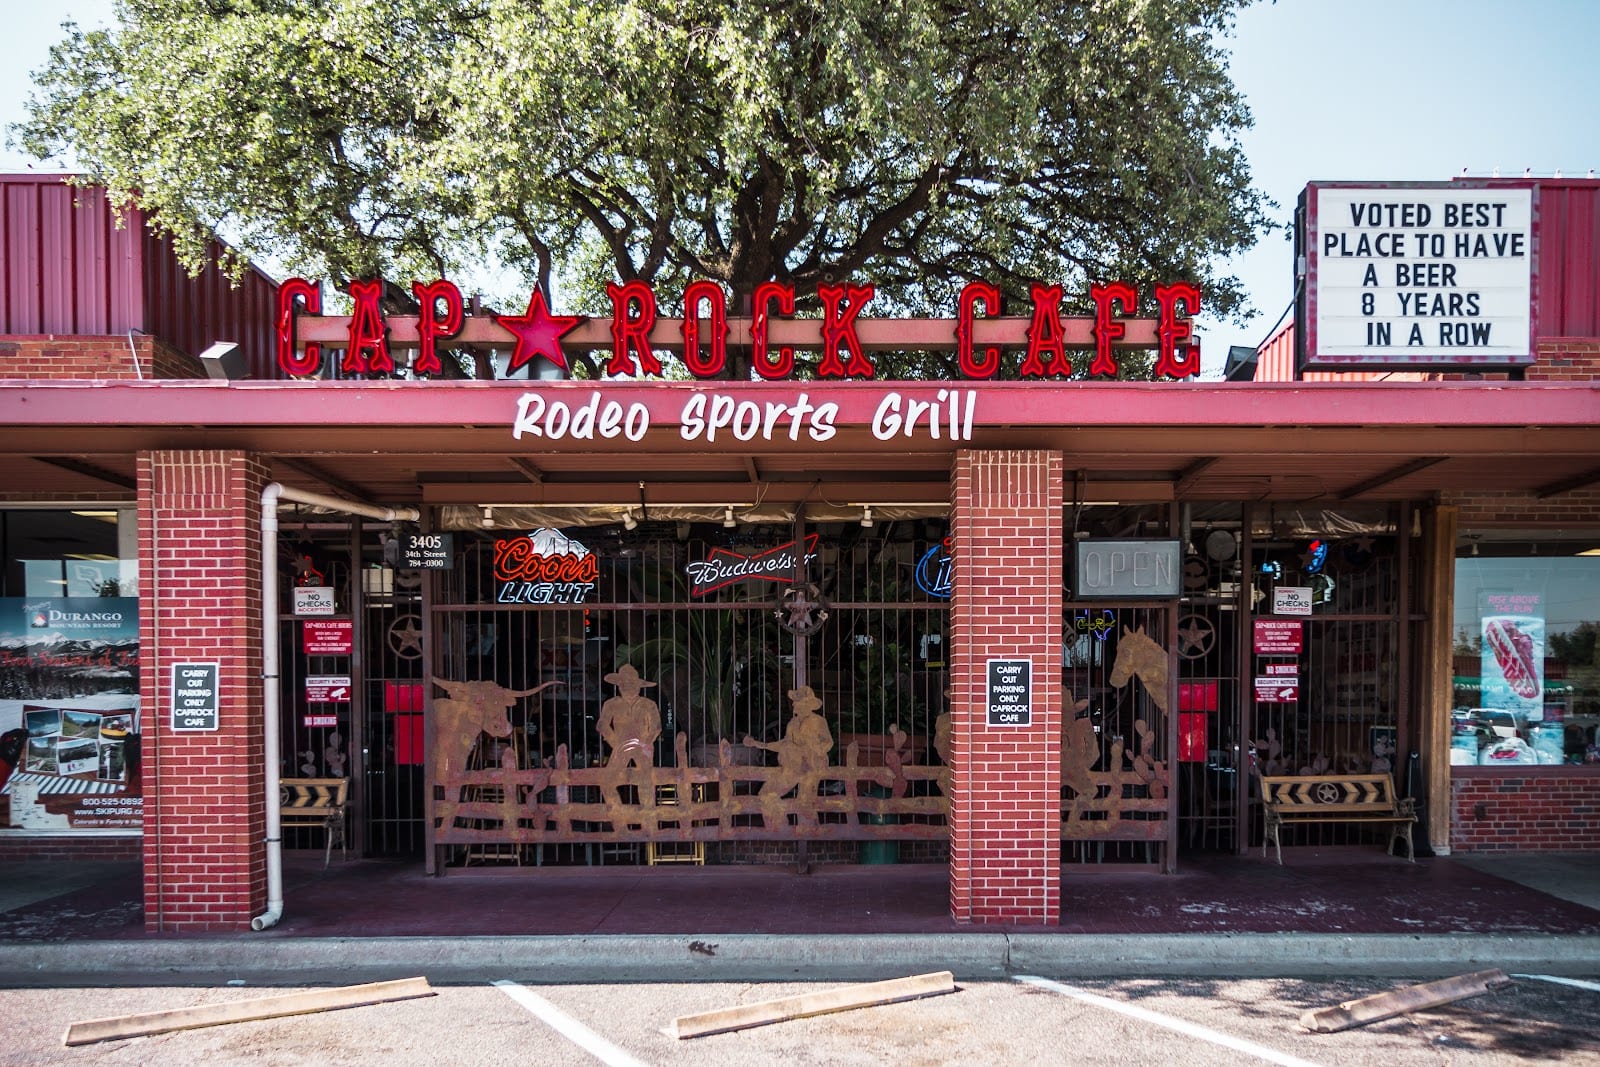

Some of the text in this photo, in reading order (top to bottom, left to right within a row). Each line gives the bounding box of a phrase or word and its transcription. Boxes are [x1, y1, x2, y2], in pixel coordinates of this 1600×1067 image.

[1350, 202, 1508, 228] VOTED BEST
[1323, 232, 1525, 258] PLACE TO HAVE
[1362, 263, 1458, 287] A BEER
[1361, 292, 1481, 317] 8 YEARS
[275, 277, 1202, 379] CAP ROCK CAFE
[1367, 322, 1492, 347] IN A ROW
[511, 391, 650, 442] Rodeo
[871, 390, 977, 442] Grill
[409, 535, 442, 549] 3405
[494, 536, 600, 583] Coors
[1086, 551, 1171, 588] OPEN
[498, 581, 595, 604] LIGHT
[181, 669, 209, 677] CARRY
[178, 689, 212, 697] PARKING
[992, 685, 1025, 693] PARKING
[175, 708, 214, 716] CAPROCK
[184, 718, 205, 726] CAFE
